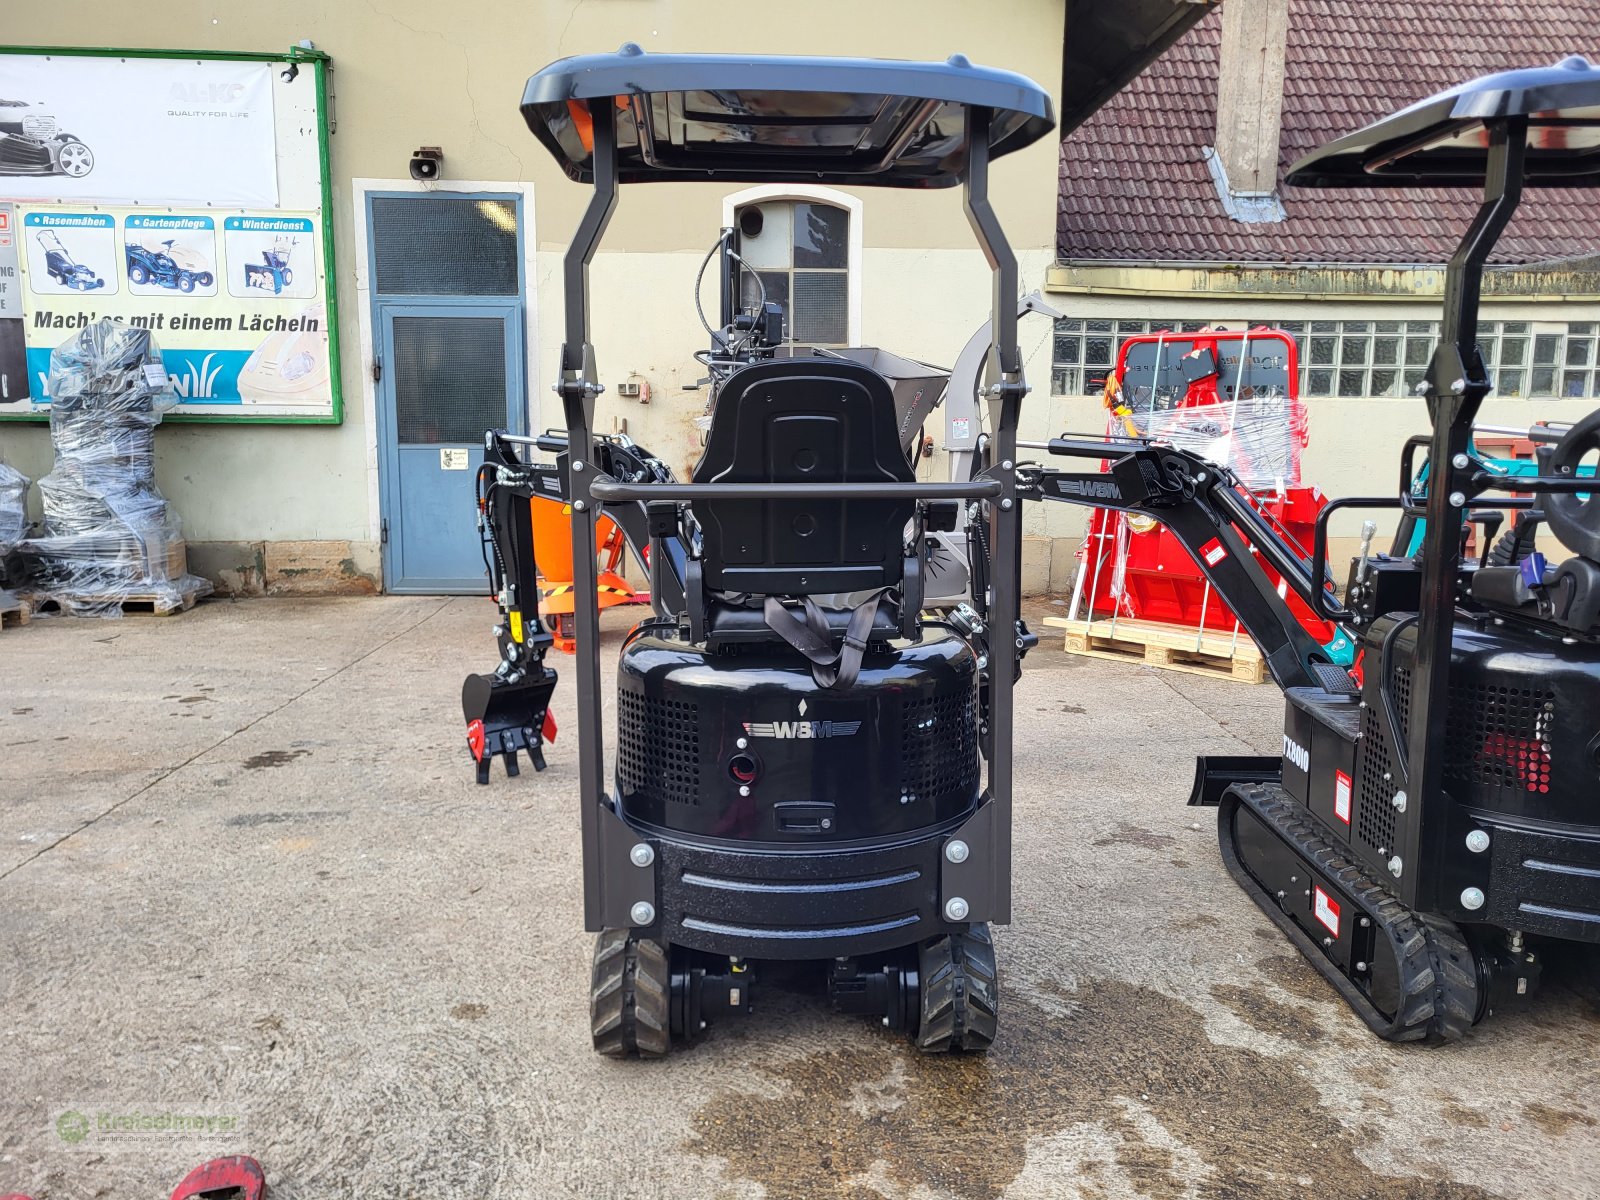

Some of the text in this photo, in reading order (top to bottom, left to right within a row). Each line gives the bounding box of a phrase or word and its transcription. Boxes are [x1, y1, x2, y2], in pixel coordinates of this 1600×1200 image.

[42, 215, 106, 227] Rasenmähen
[142, 218, 206, 230] Gartenpflege
[242, 219, 305, 230] Winterdienst
[131, 312, 163, 330] mit
[169, 314, 232, 331] einem
[239, 313, 319, 332] Lächeln
[1283, 734, 1309, 773] TX8010
